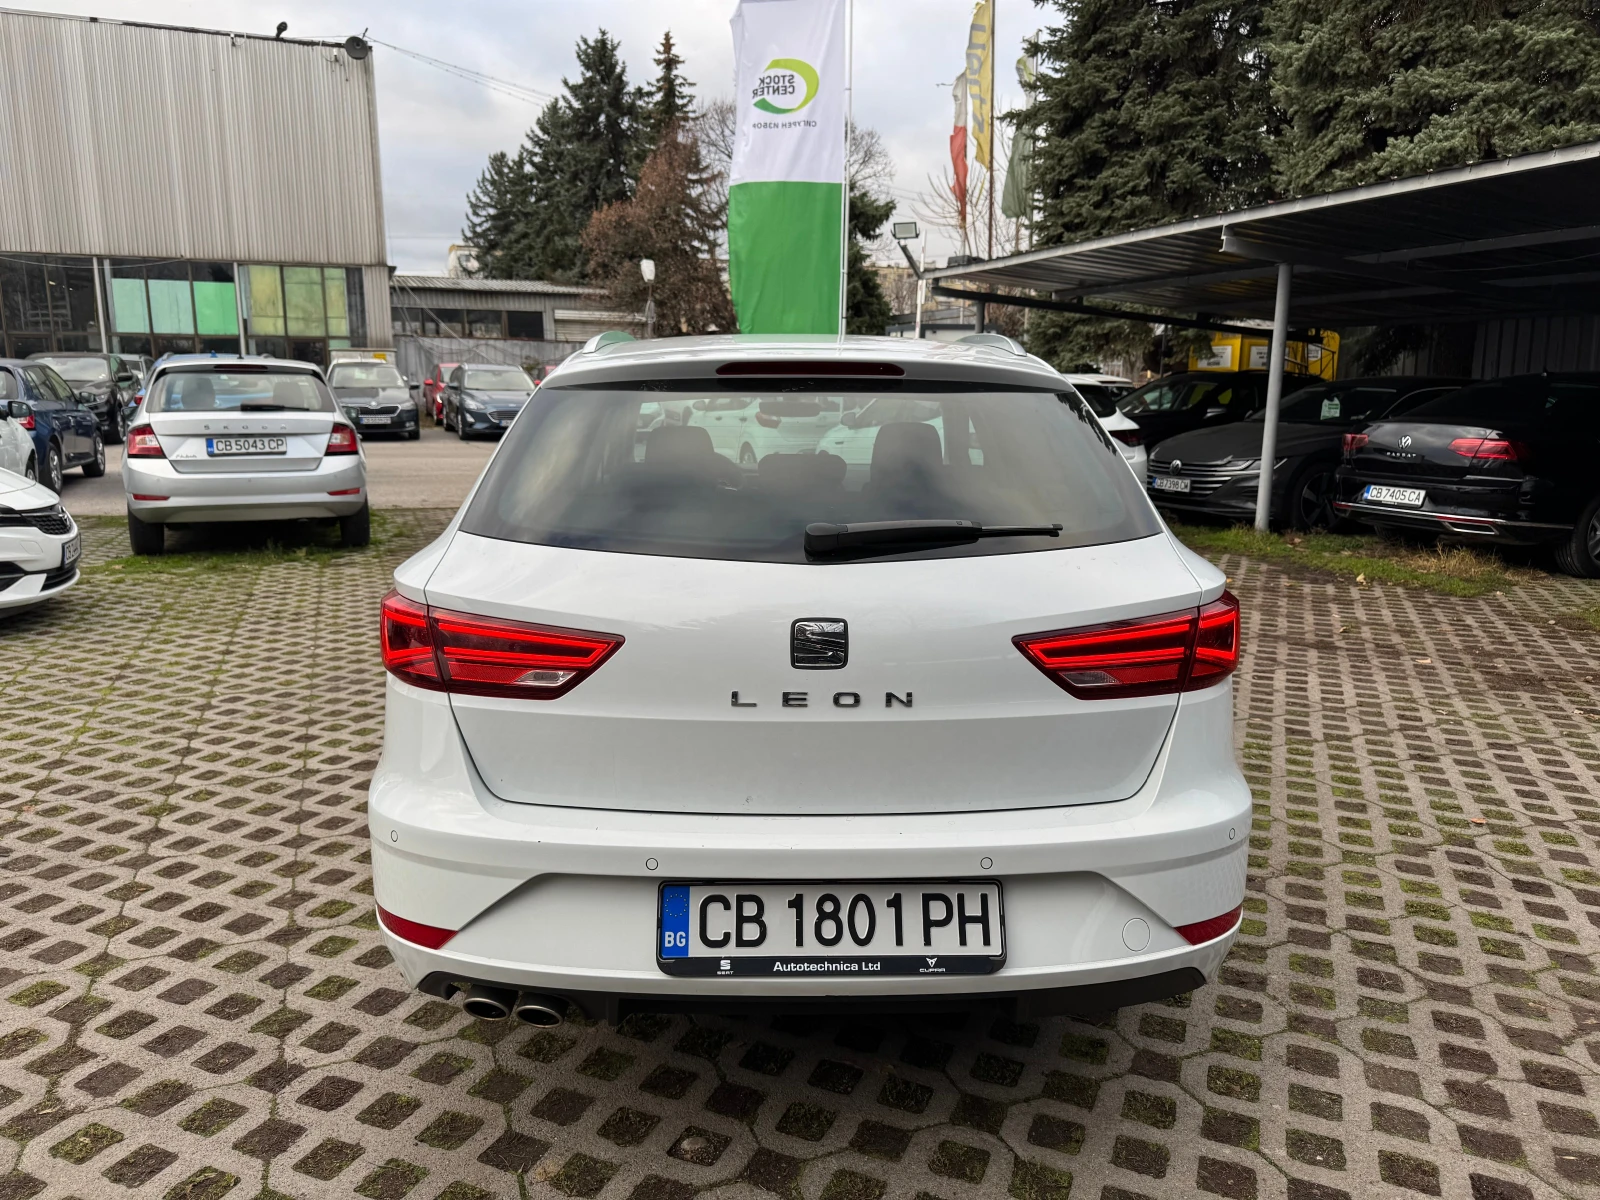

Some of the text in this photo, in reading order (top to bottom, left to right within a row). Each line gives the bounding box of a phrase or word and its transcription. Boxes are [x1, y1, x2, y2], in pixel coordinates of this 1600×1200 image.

[216, 438, 284, 451] CB 5043 CP
[1370, 487, 1383, 499] CB
[1383, 488, 1407, 501] 7405
[1408, 490, 1421, 503] CA
[731, 690, 913, 708] LEON
[698, 892, 991, 949] CB 1801 PH
[664, 931, 686, 947] BG
[773, 961, 881, 972] Autotechnica Ltd
